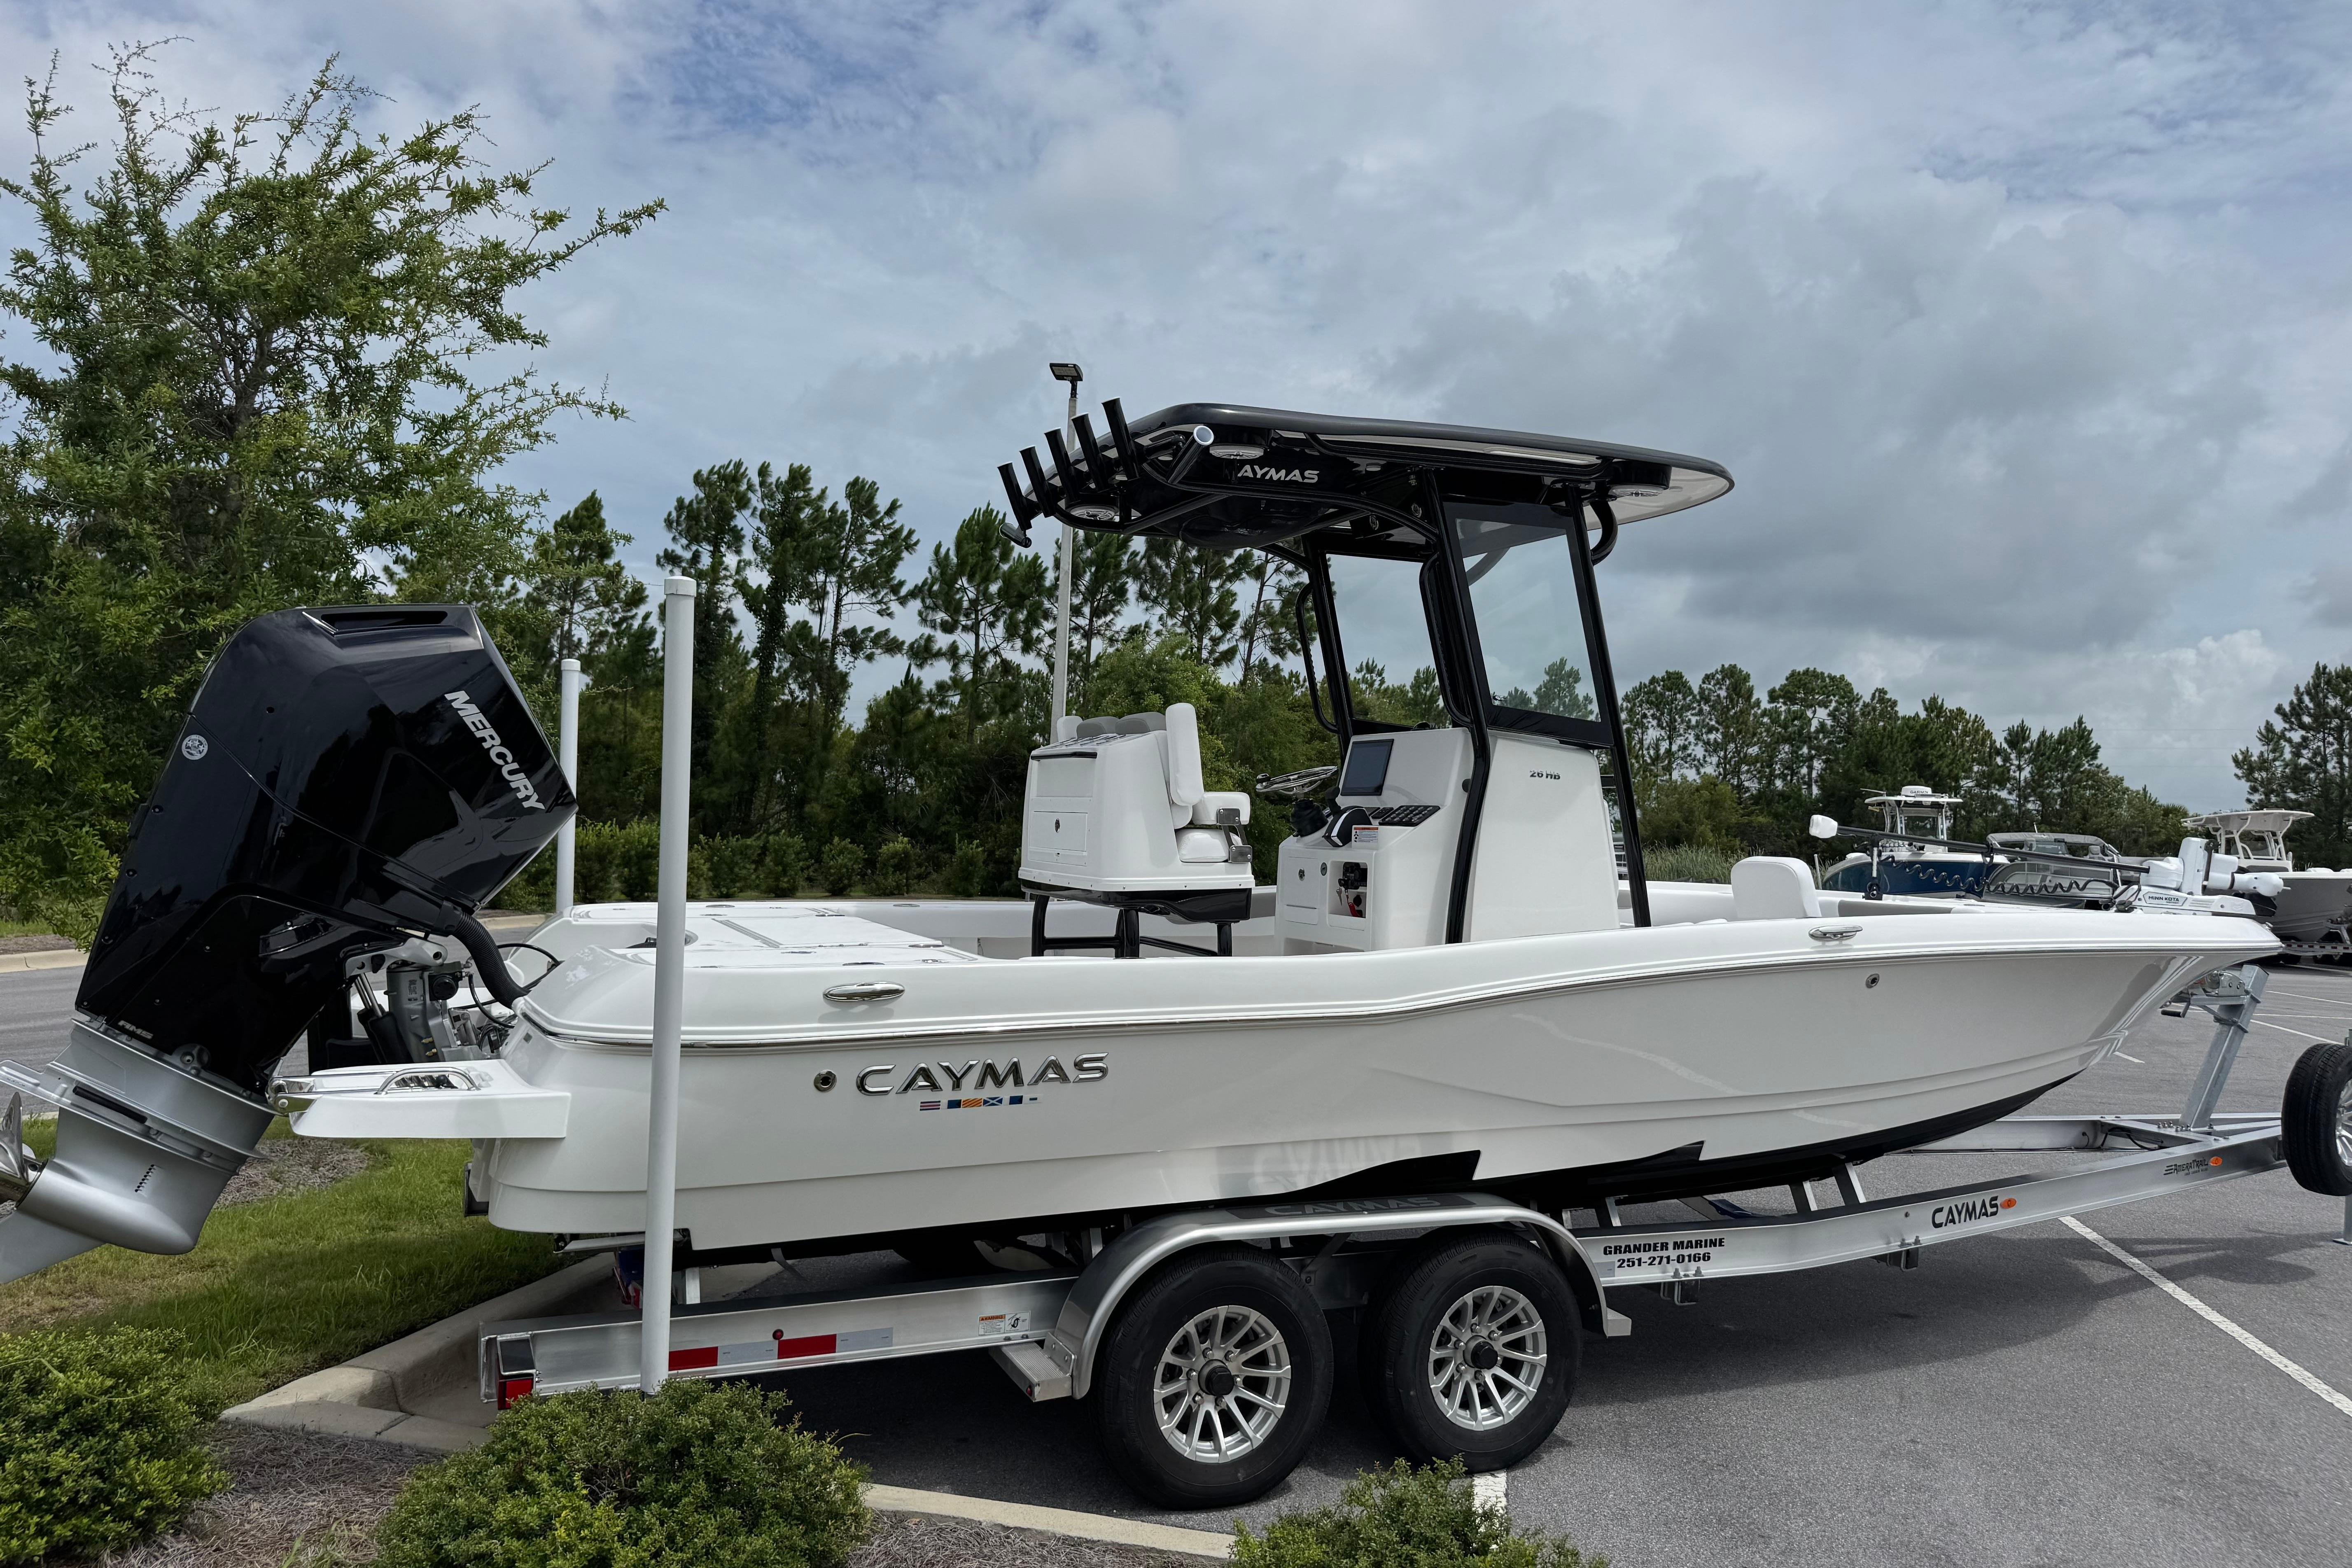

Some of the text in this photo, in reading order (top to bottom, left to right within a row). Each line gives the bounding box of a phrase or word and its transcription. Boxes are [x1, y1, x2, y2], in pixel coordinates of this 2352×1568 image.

[1237, 464, 1320, 483] AYMAS
[444, 690, 545, 810] MERCURY
[1545, 770, 1561, 780] HB
[856, 1052, 1109, 1096] CAYMAS
[1932, 1195, 1998, 1229] CAYMAS
[1603, 1237, 1725, 1255] GRANDER MARINE
[1617, 1252, 1711, 1268] 251-271-0166
